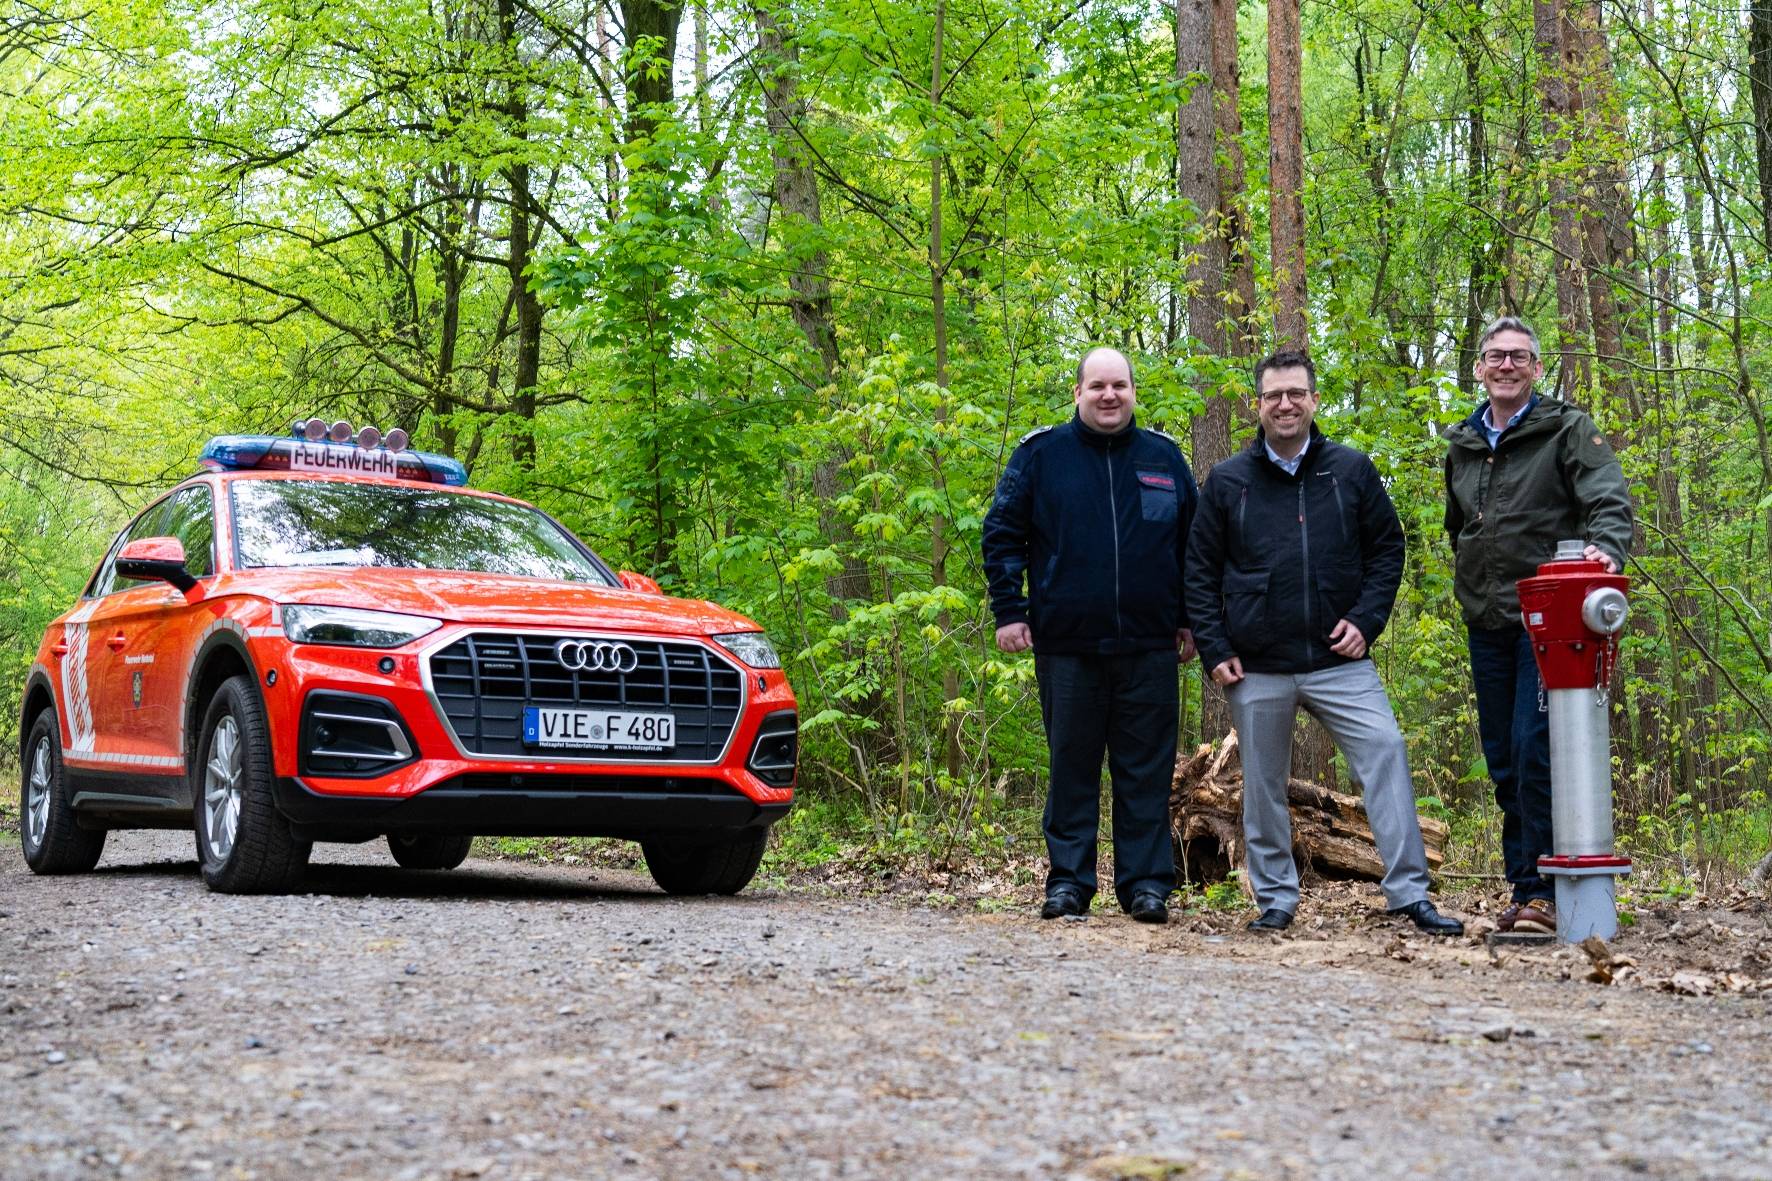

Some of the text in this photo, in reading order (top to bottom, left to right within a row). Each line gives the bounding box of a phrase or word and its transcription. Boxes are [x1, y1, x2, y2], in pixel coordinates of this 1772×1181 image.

[294, 446, 394, 474] FEUERWEHR
[542, 712, 671, 741] VIE F 480
